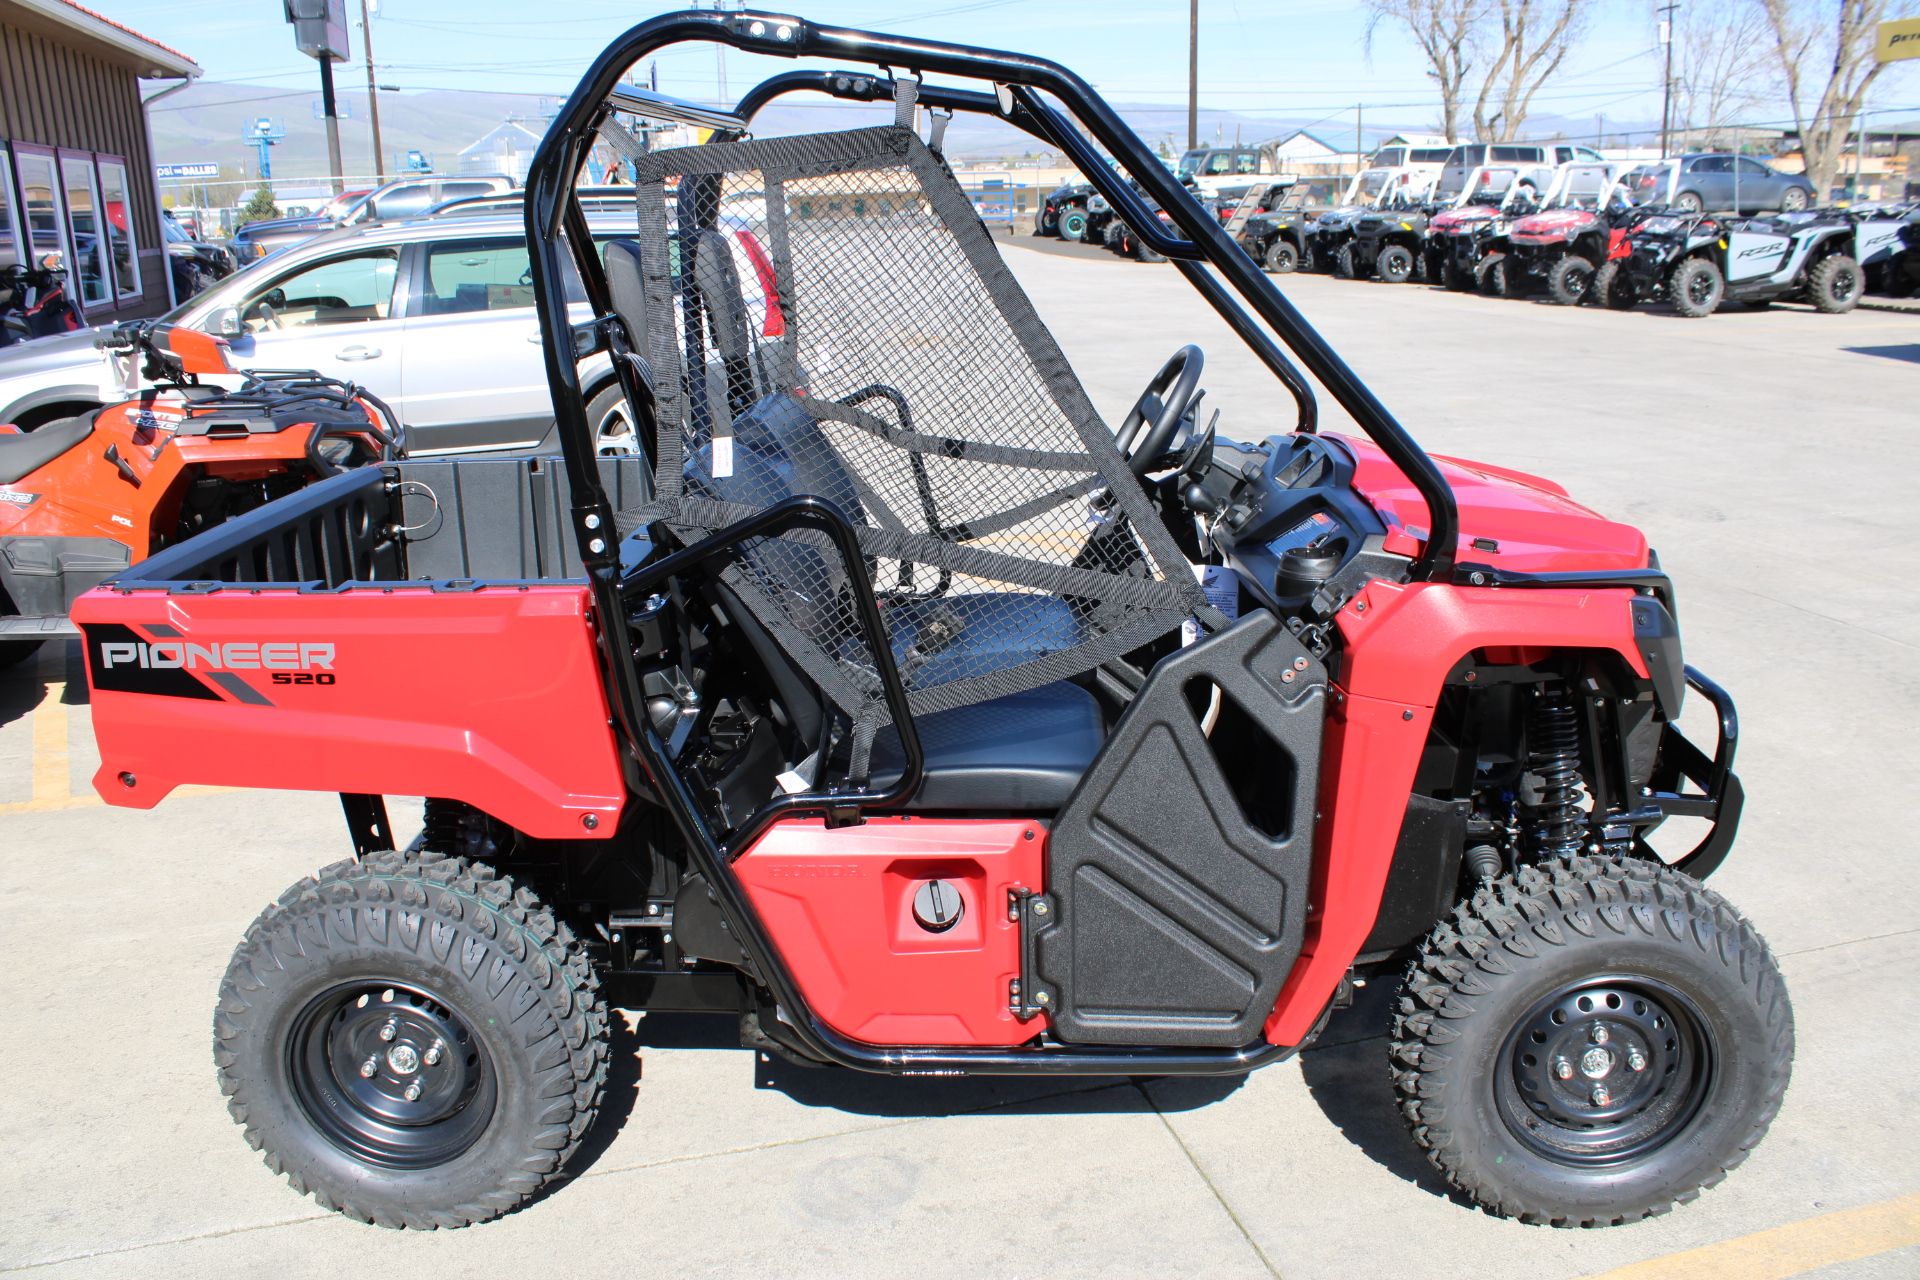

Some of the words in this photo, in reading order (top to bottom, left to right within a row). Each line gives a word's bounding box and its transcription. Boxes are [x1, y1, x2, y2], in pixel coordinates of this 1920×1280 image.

[156, 166, 173, 177] psi
[182, 165, 217, 175] DALLES
[1864, 232, 1898, 247] RZ
[1736, 242, 1783, 260] RZR
[101, 642, 336, 670] PIONEER
[272, 673, 336, 685] 520
[767, 863, 871, 880] HONDA
